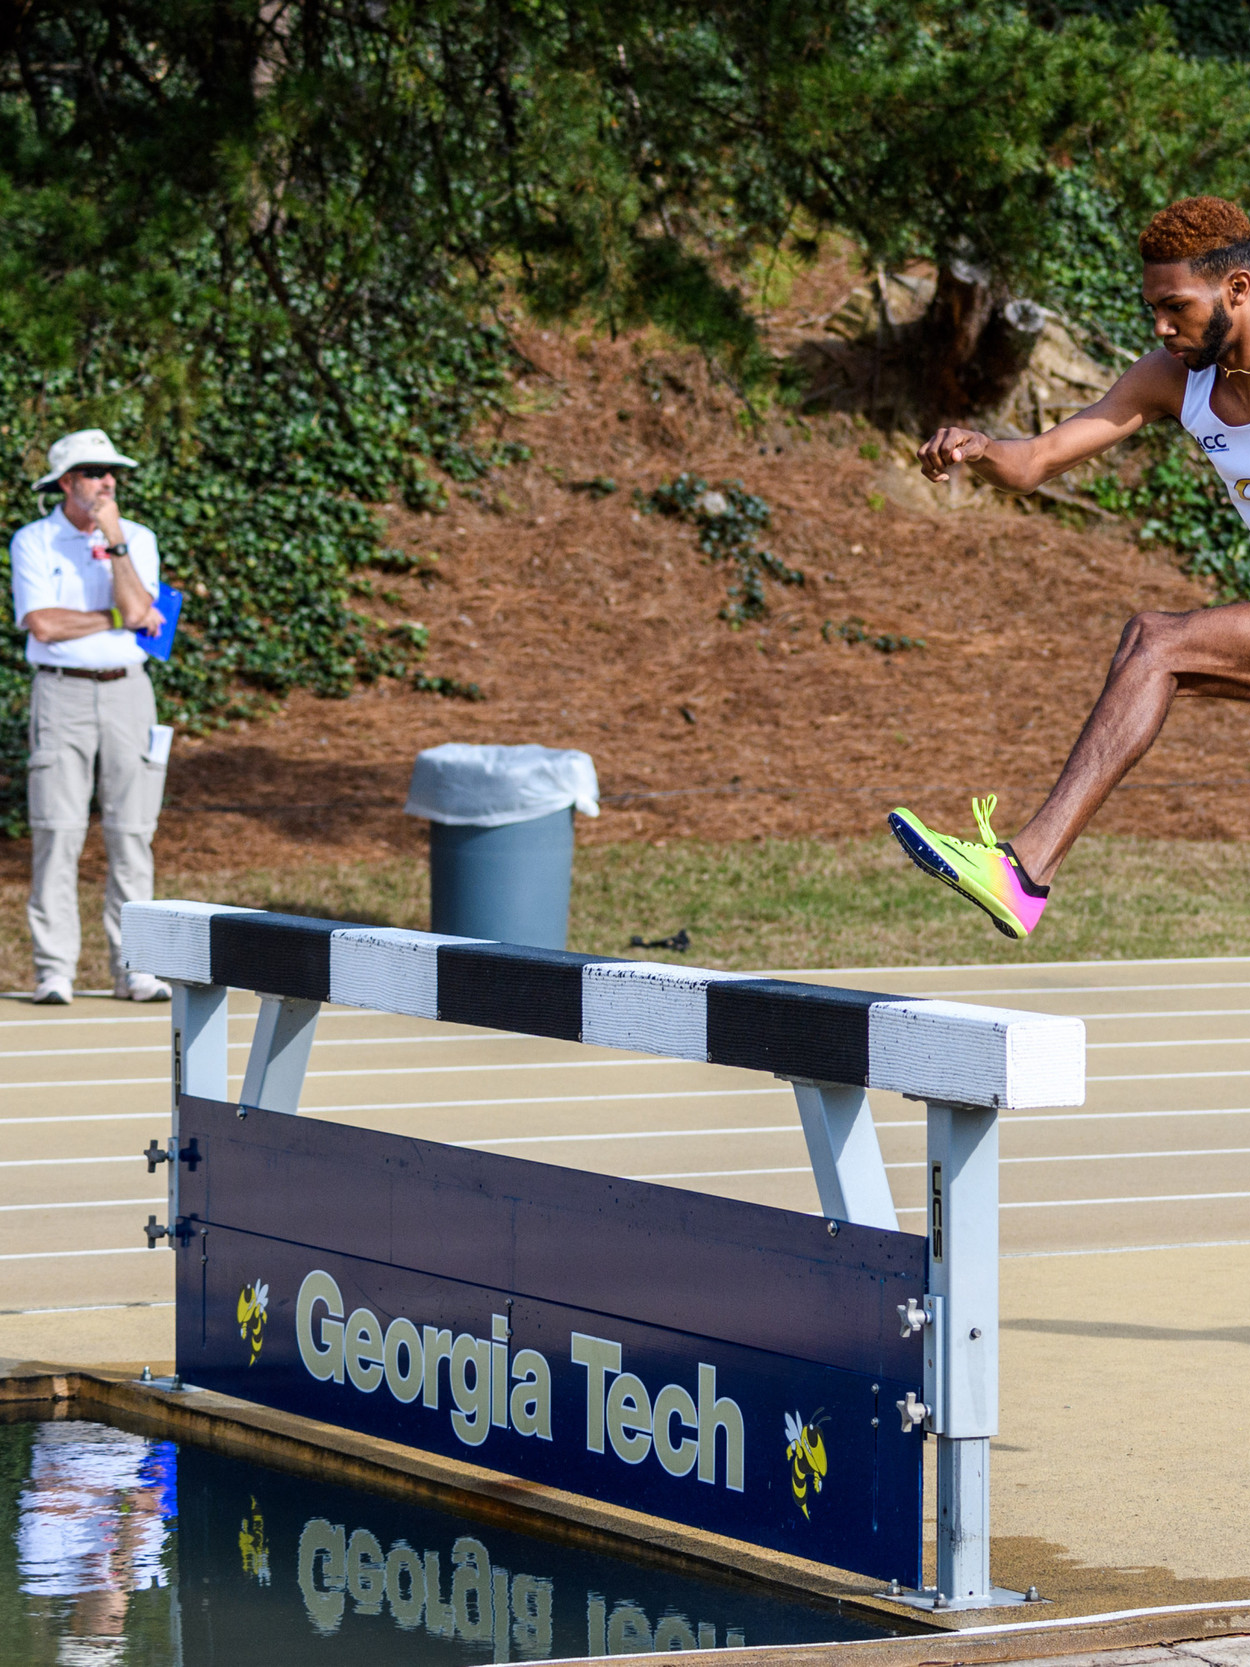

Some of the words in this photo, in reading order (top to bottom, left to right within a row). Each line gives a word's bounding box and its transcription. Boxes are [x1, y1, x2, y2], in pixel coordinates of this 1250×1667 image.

[932, 1166, 943, 1258] UCS
[296, 1269, 553, 1447] Georgia
[571, 1331, 744, 1493] Tech
